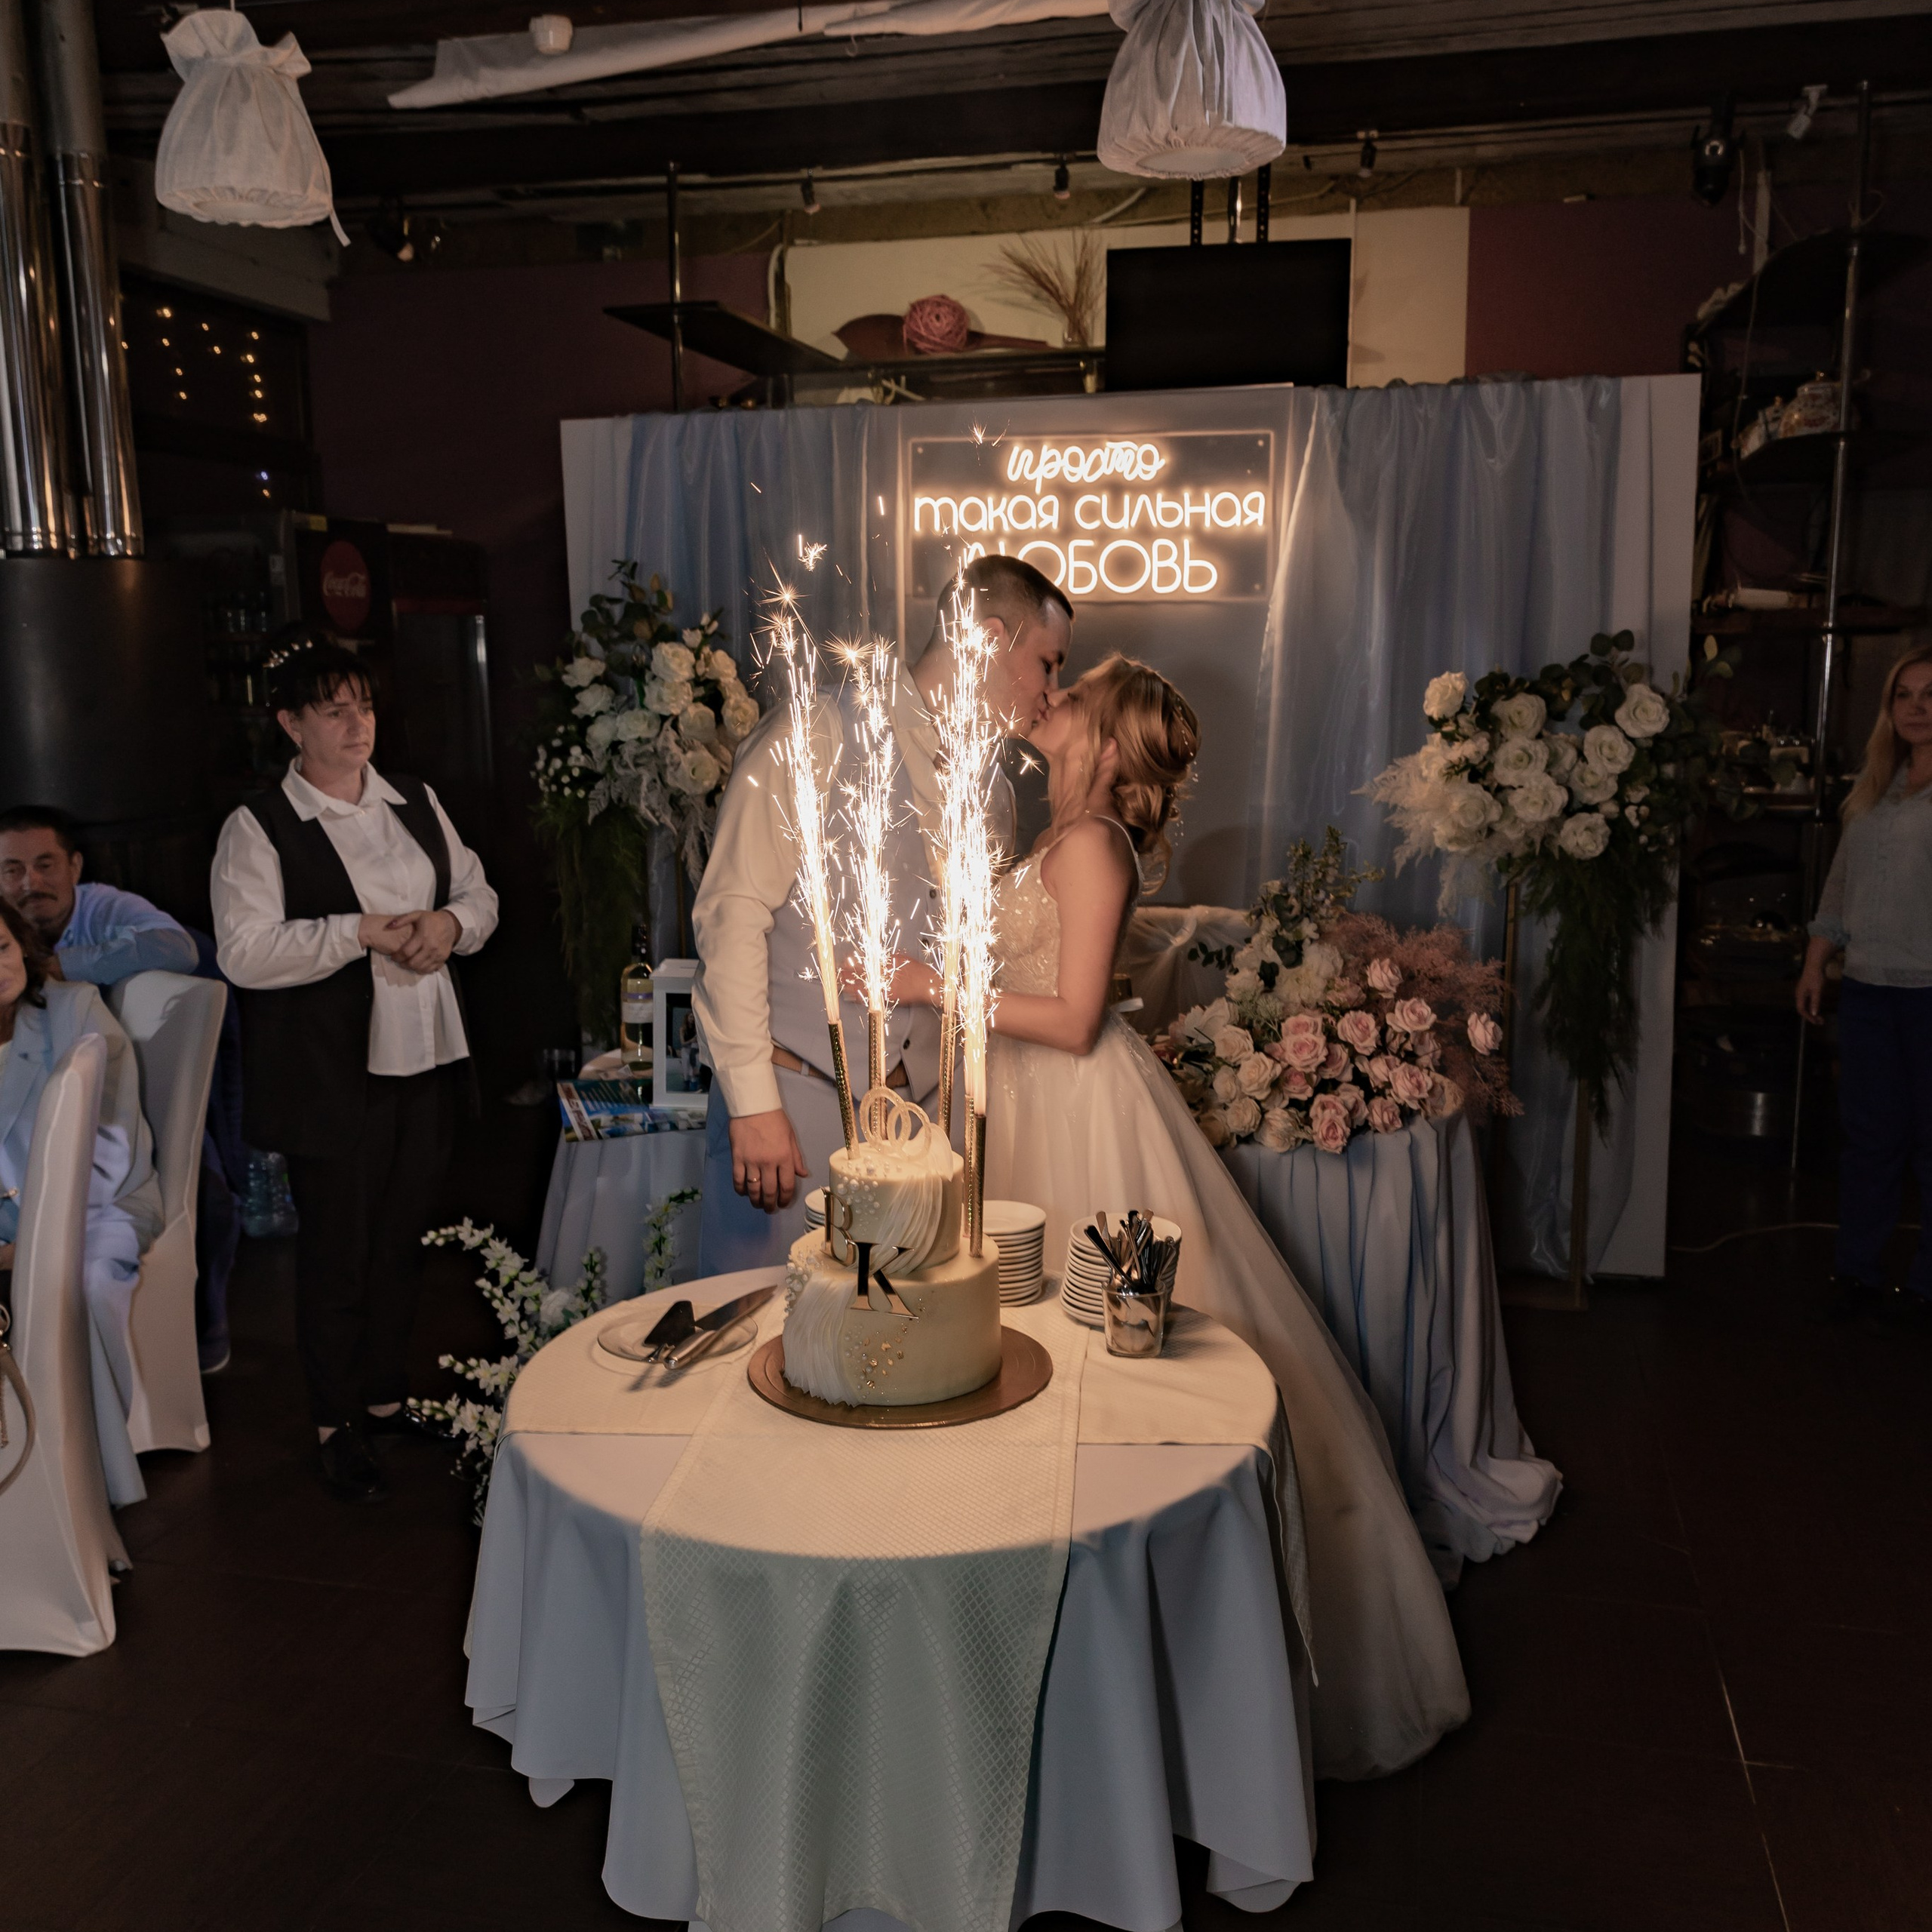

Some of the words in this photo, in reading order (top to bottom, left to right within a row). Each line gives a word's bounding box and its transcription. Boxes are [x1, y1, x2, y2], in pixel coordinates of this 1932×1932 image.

[1006, 440, 1165, 494] просто
[913, 494, 1060, 534] такая
[1074, 491, 1266, 531] сильная
